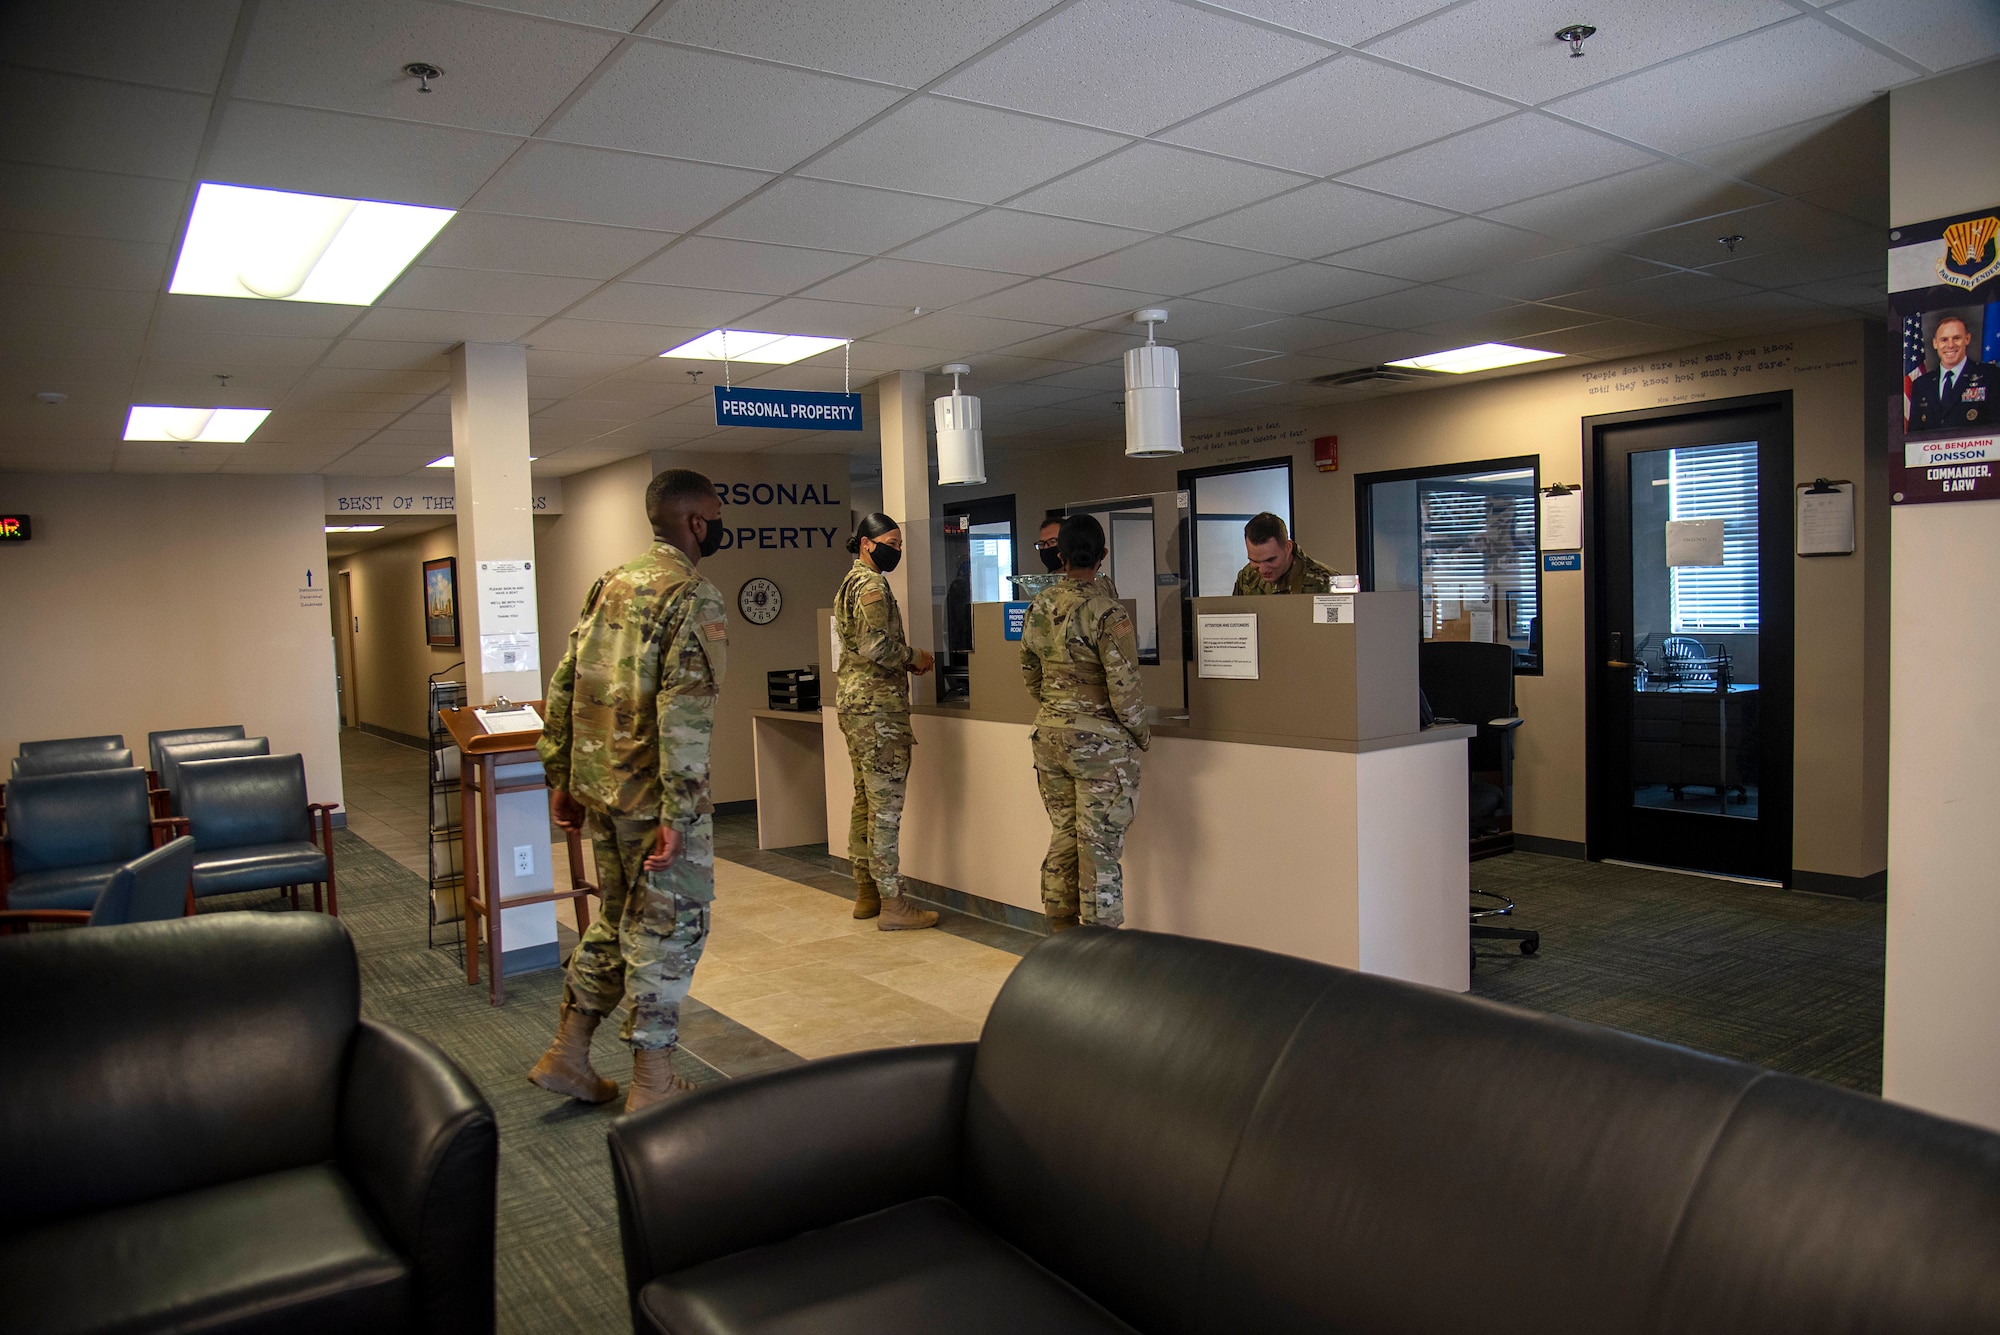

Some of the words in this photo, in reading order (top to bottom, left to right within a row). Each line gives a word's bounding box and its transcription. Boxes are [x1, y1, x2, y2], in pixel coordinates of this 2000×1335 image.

[1938, 269, 1959, 285] PARATI
[1622, 364, 1645, 375] don't
[1650, 361, 1673, 371] care
[1679, 357, 1699, 367] how
[1704, 351, 1732, 363] much
[1737, 347, 1757, 361] you
[1763, 342, 1794, 354] know
[1588, 384, 1610, 395] until
[1615, 381, 1637, 391] they
[1642, 376, 1669, 387] know
[1674, 372, 1695, 383] how
[1700, 367, 1728, 378] much
[1732, 364, 1753, 377] you
[722, 400, 788, 418] PERSONAL
[791, 403, 855, 420] PROPERTY
[1922, 444, 1943, 452] COL
[1945, 439, 1993, 450] BENJAMIN
[1929, 450, 1986, 464] JONSSON
[714, 483, 841, 505] RSONAL
[1942, 480, 1950, 492] 6
[1951, 478, 1976, 492] ARW
[337, 496, 382, 510] BEST
[392, 496, 413, 510] OF
[422, 496, 454, 510] THE
[715, 527, 838, 550] OPERTY
